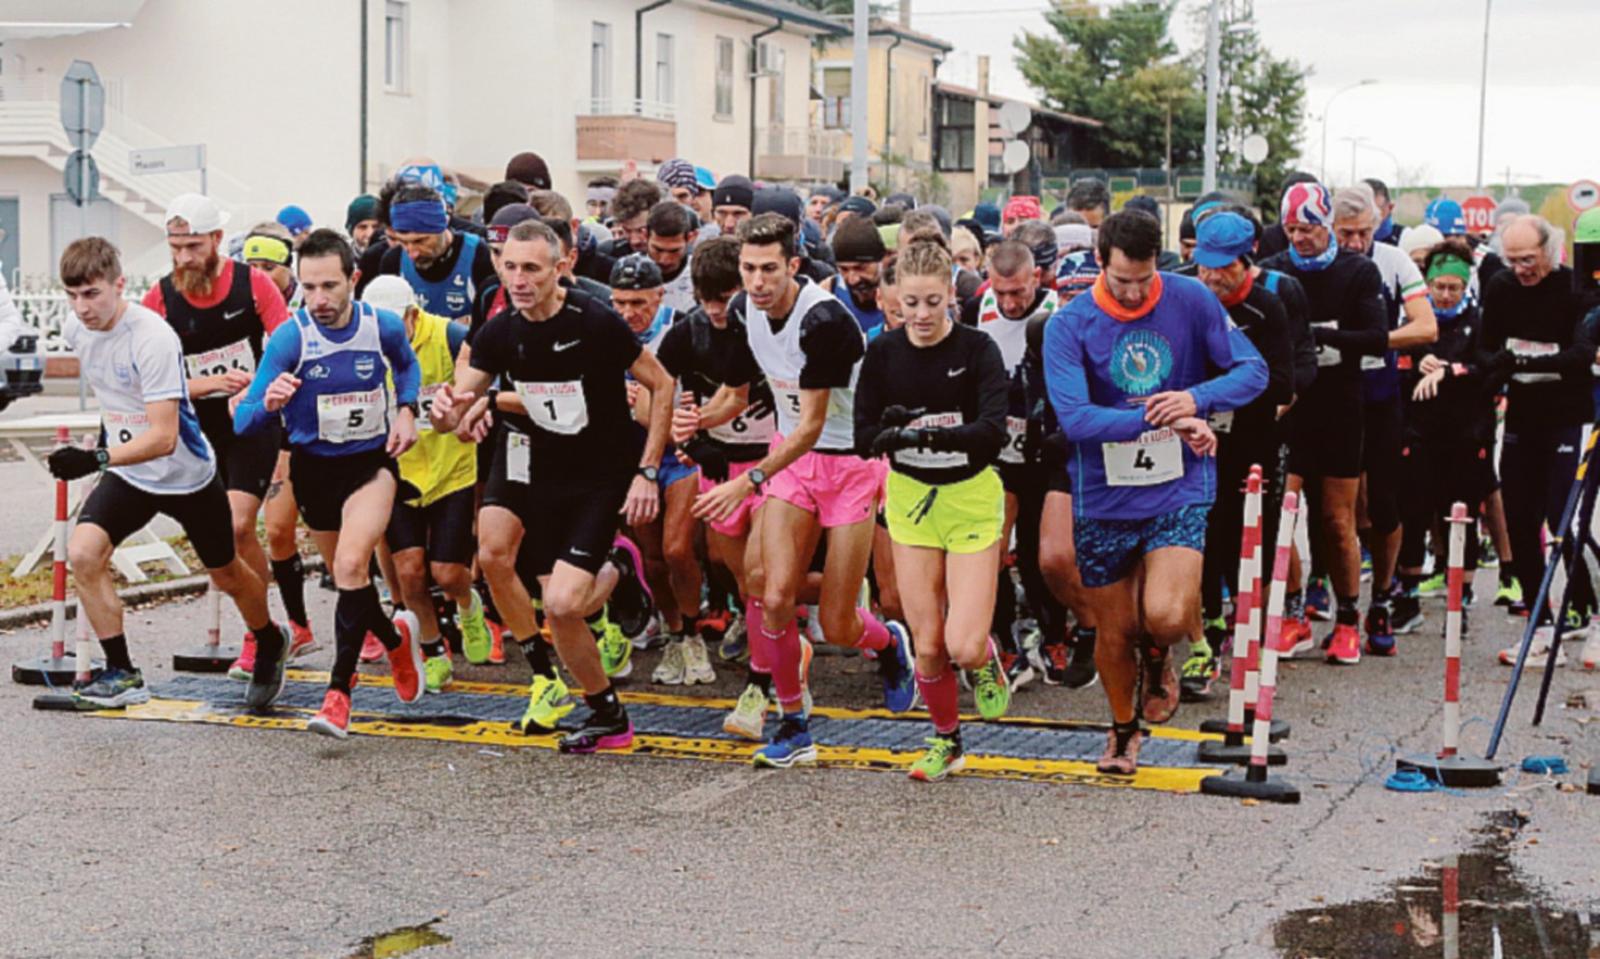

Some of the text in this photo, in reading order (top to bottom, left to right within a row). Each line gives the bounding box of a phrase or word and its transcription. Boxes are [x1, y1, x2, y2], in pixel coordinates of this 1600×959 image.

[347, 409, 364, 428] 5
[543, 400, 557, 421] 1
[1133, 449, 1156, 471] 4
